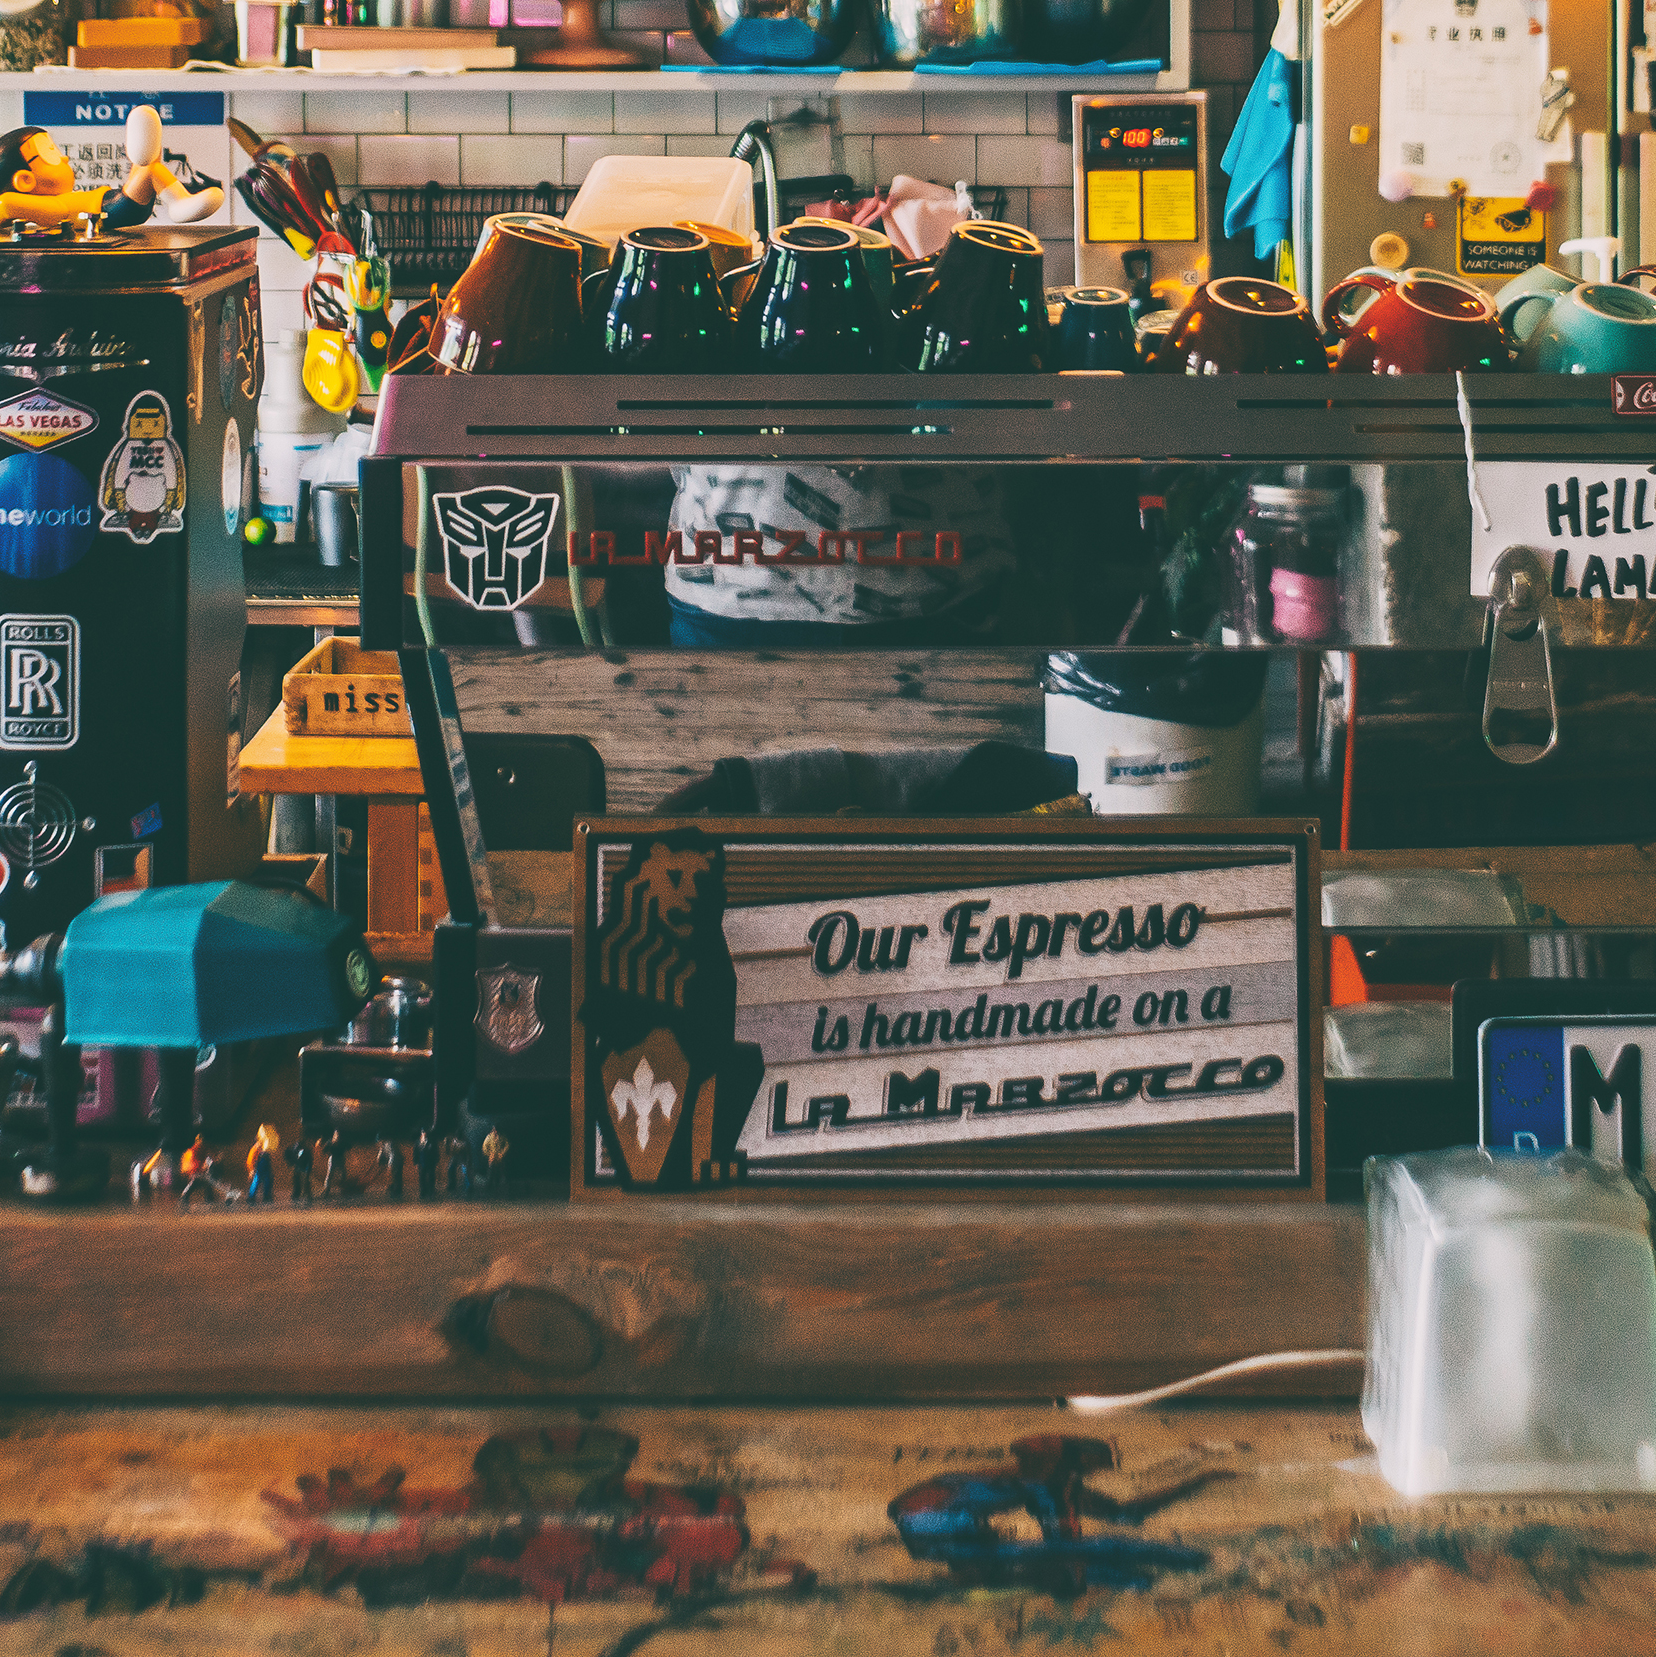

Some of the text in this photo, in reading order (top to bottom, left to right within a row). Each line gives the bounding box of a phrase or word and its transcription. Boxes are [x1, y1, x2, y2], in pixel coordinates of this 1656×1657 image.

[75, 104, 174, 120] NOTE
[1467, 245, 1525, 256] SOMEONE
[1465, 259, 1529, 271] WATCHING
[30, 414, 83, 428] VEGAS
[129, 454, 165, 469] MCC
[569, 531, 962, 566] LA MARZOCCO
[8, 626, 66, 641] ROLLS
[323, 682, 400, 715] miss
[8, 722, 63, 736] ROYCE
[807, 897, 1207, 981] Our Espresso
[810, 984, 1234, 1053] is handmade on a
